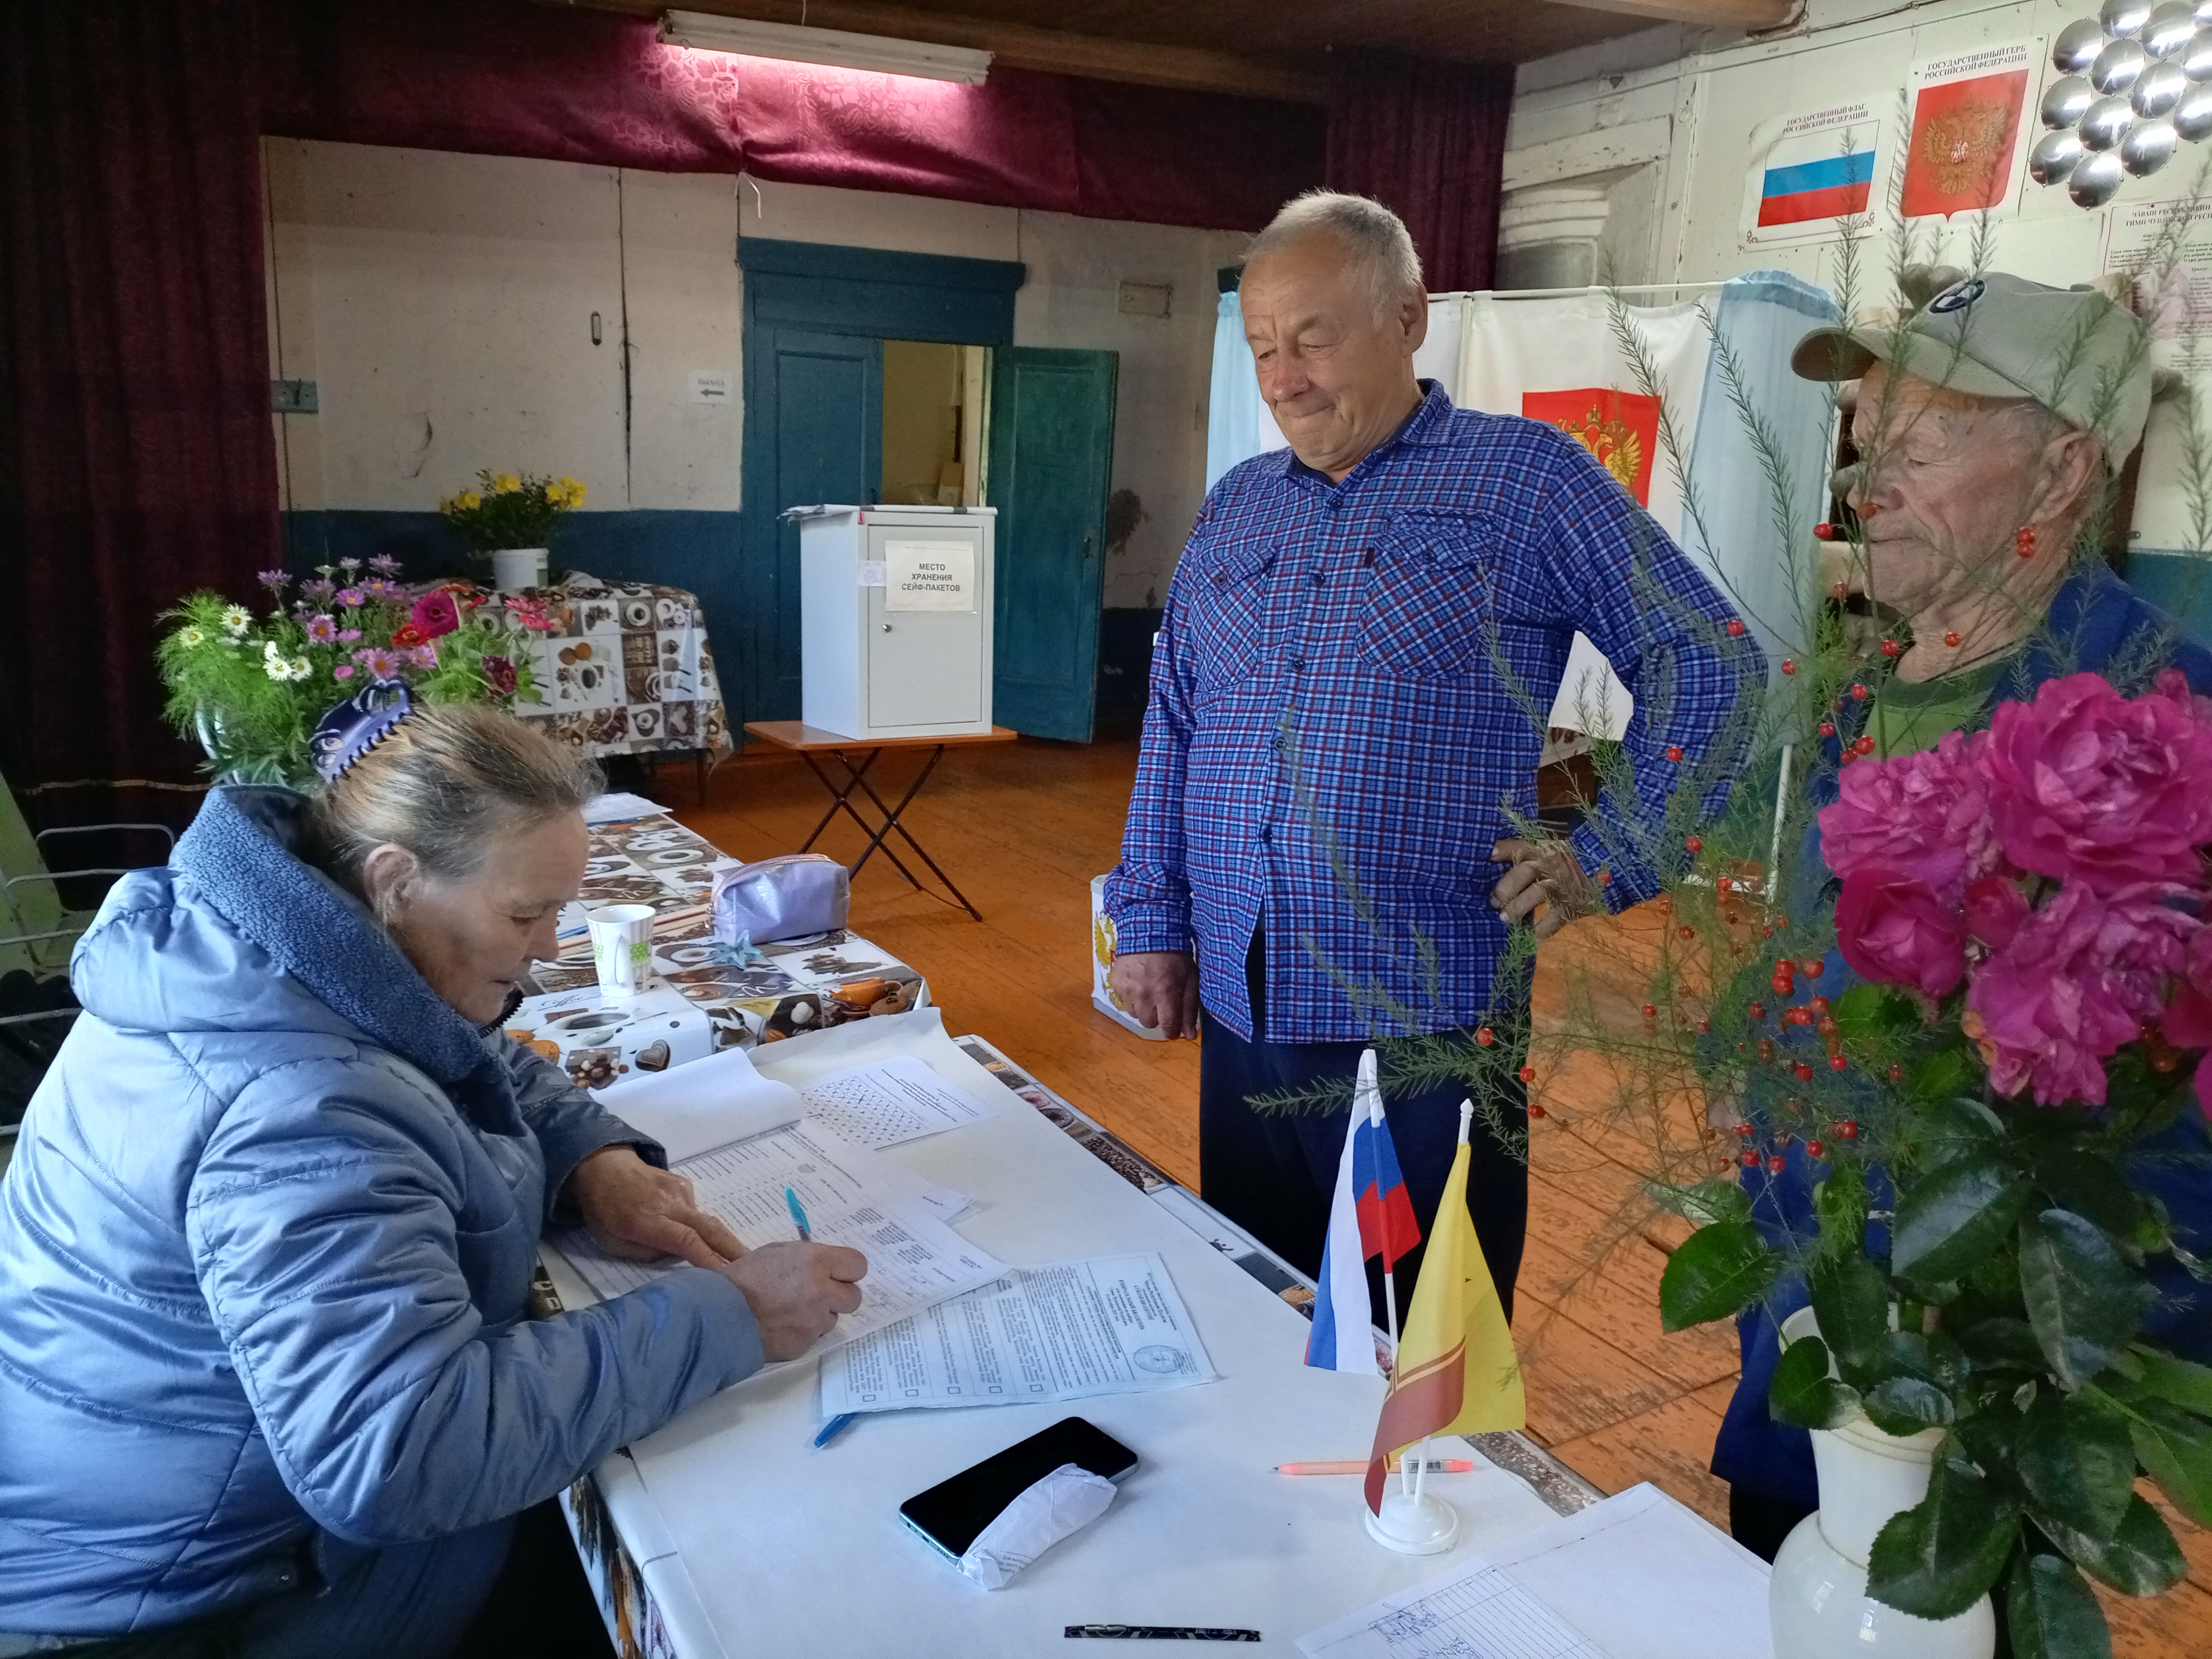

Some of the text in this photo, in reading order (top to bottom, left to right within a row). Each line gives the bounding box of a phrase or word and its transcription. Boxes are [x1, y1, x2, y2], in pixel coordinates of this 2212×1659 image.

[1924, 53, 2027, 80] РОССИЙСКОЙ ФЕДЕРАЦИИ
[1928, 45, 2026, 71] ГОСУДАРСТВЕННЫЙ ГЕРБ
[1783, 110, 1868, 134] РОССИЙСКОЙ ФЕДЕРАЦИИ
[1787, 103, 1866, 126] ГОСУДАРСТВЕННЫЙ ФЛАГ
[919, 563, 946, 571] МЕСТО
[902, 582, 960, 591] СЕЙФ-ПАКЕТОВ
